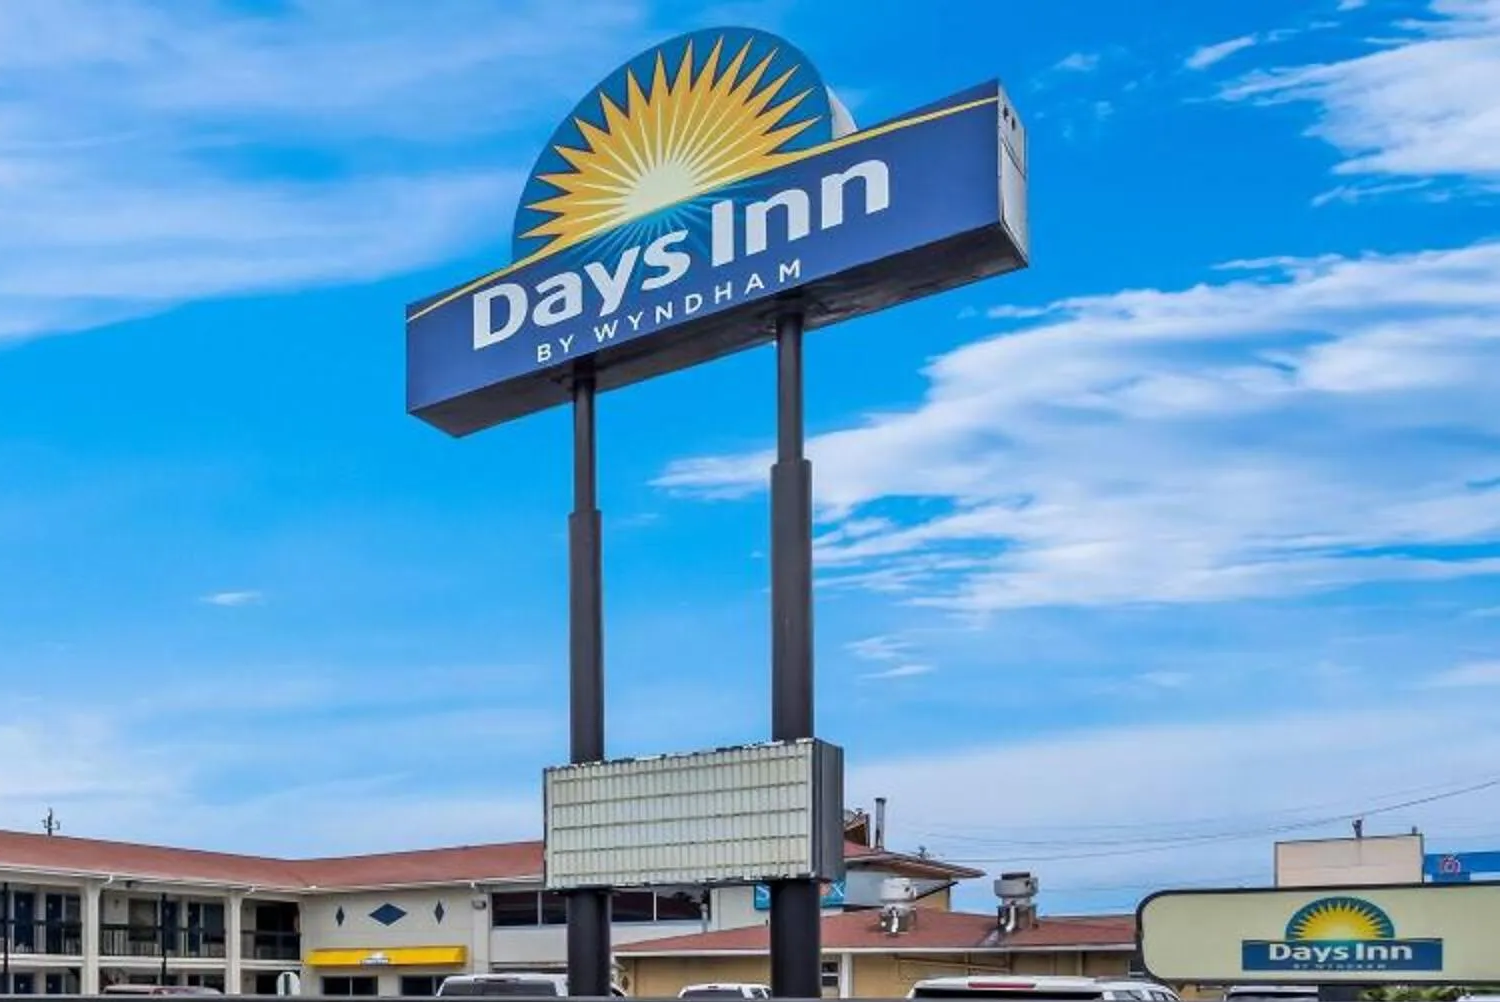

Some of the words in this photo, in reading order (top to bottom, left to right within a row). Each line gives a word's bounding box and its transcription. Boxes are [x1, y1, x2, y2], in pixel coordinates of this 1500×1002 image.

[473, 229, 691, 350] Days
[711, 159, 890, 268] Inn
[537, 335, 574, 363] BY
[593, 259, 801, 343] WYNDHAM
[1268, 943, 1349, 963] Days
[1355, 943, 1413, 961] Inn
